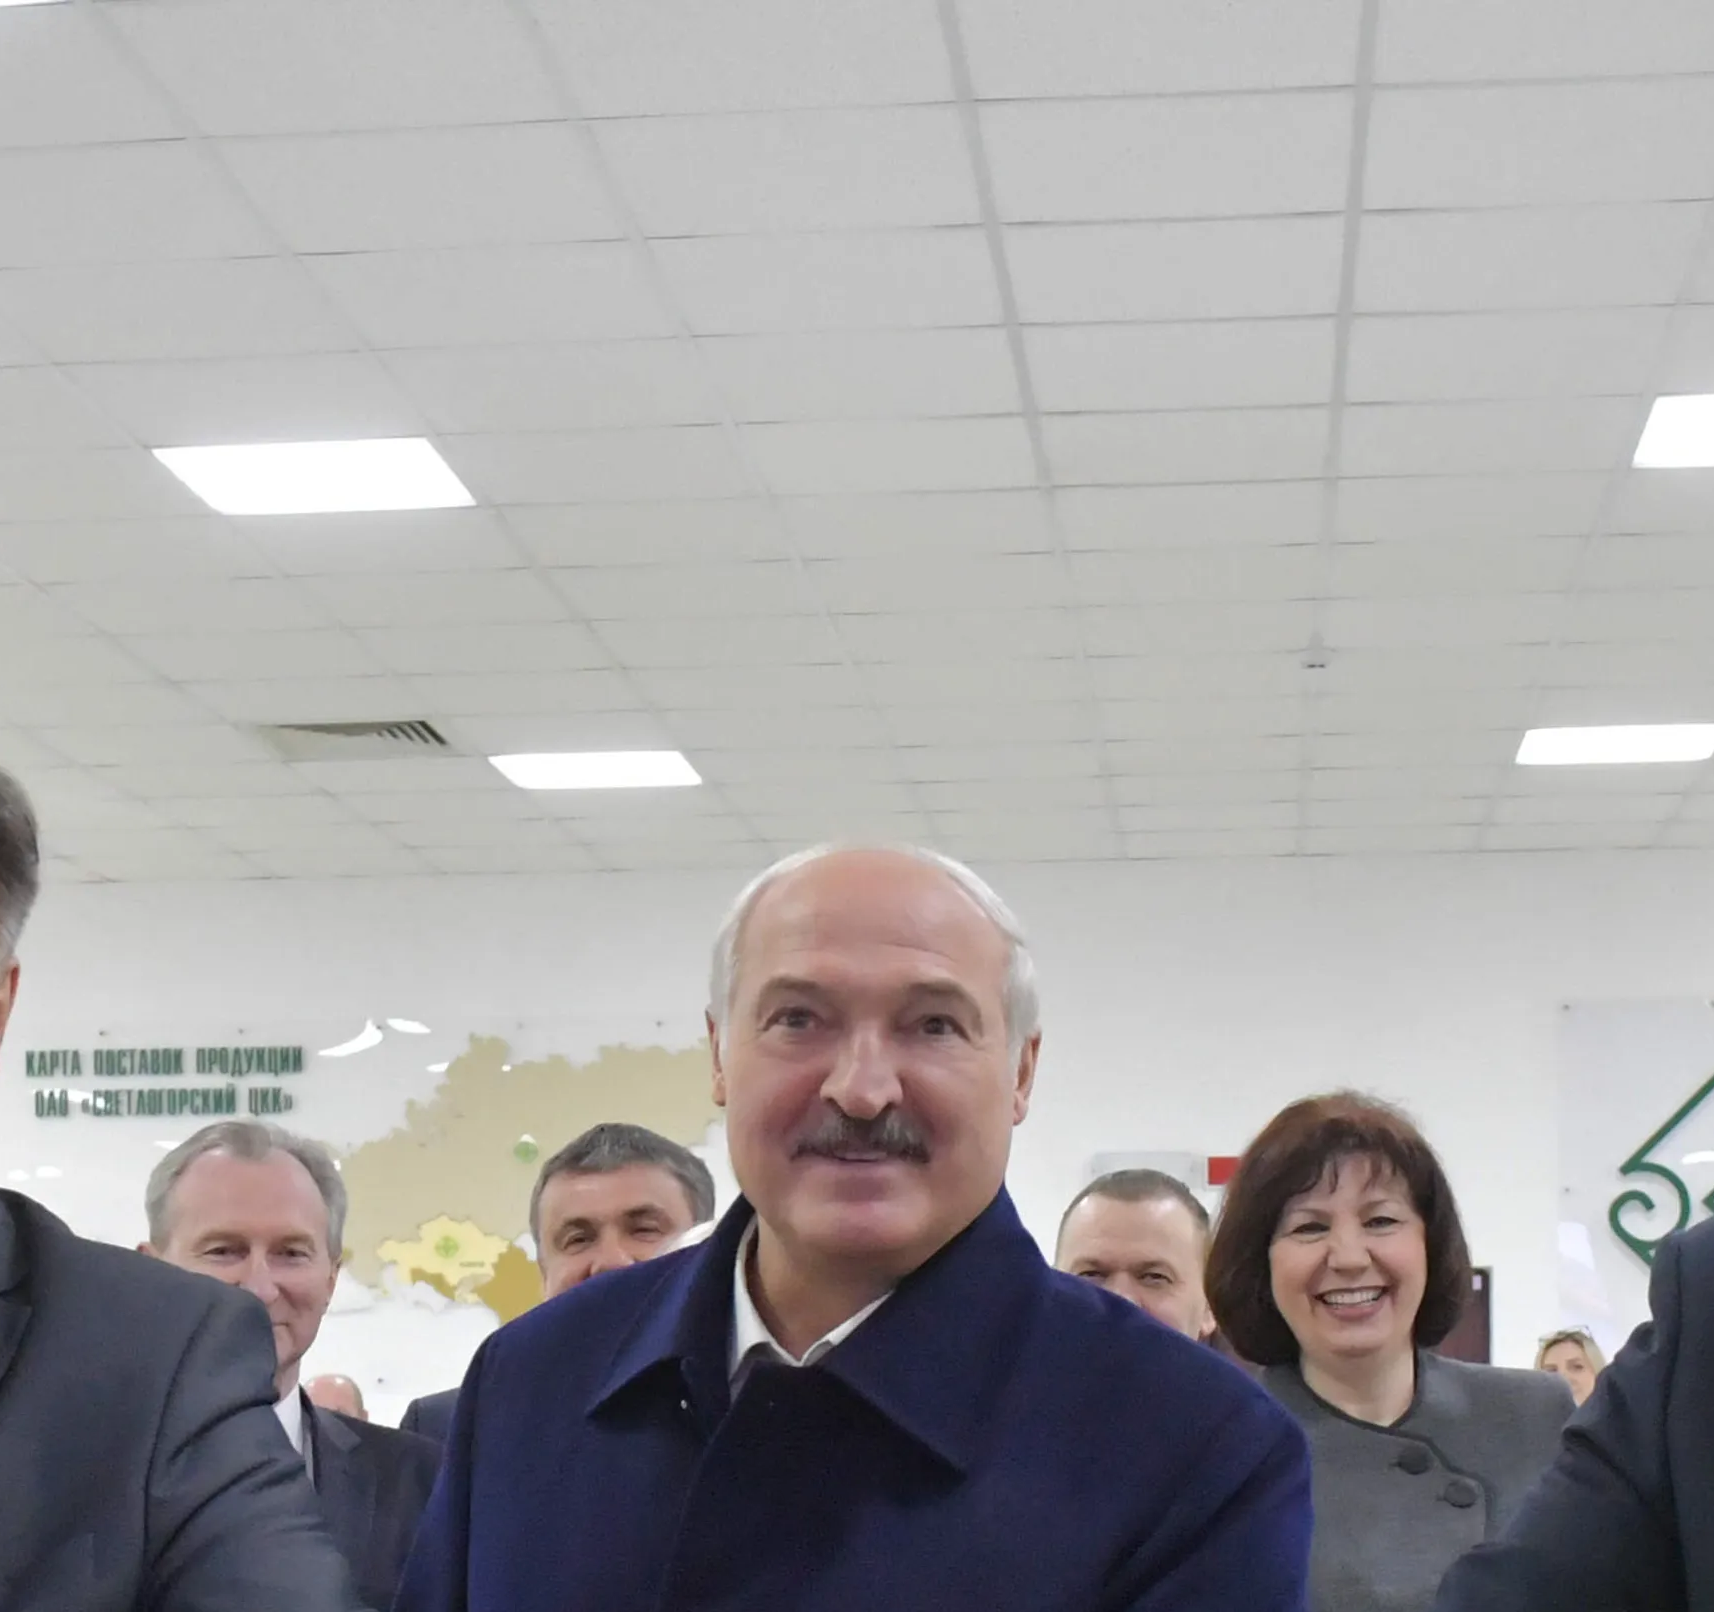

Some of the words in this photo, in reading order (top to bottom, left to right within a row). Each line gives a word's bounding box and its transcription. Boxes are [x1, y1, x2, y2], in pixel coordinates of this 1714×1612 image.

[25, 1050, 82, 1077] КАРТА
[93, 1048, 184, 1076] ПОСТАВОК
[196, 1046, 303, 1077] ПРОДУКЦИИ
[35, 1089, 68, 1118] ОАО
[81, 1083, 236, 1118] «СВЕТЛОГОРСКИЙ
[248, 1087, 294, 1117] ЦКК»
